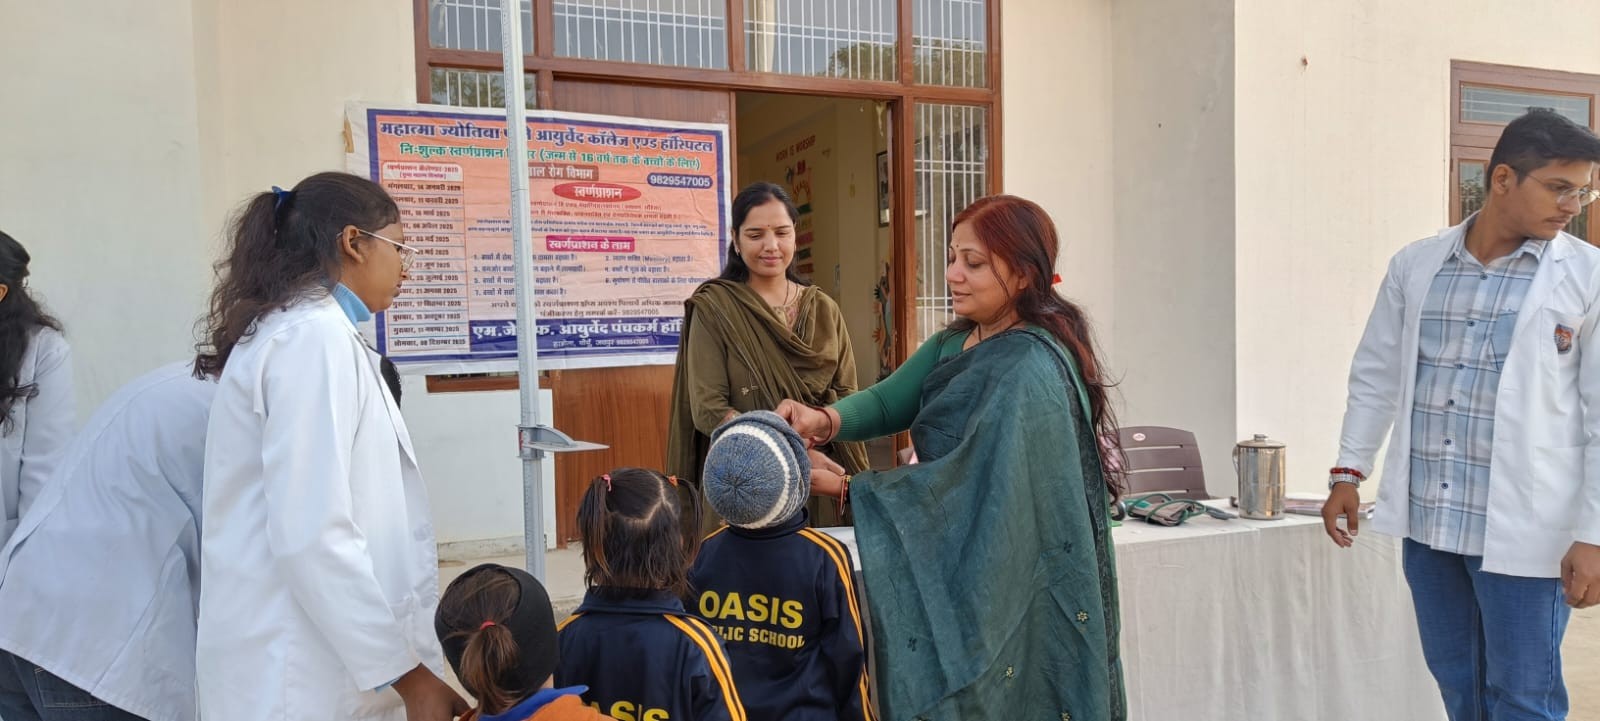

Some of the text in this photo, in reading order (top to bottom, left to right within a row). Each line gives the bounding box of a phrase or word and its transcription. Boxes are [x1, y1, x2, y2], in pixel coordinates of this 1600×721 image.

[380, 123, 435, 136] महात्मा
[440, 121, 500, 138] ज्योतिबा
[536, 127, 583, 147] आयुर्वेद
[588, 129, 629, 147] कॉलेज
[632, 137, 657, 150] एण्ड
[661, 135, 712, 151] हॉस्पिटल
[540, 148, 565, 161] (जन्म
[569, 150, 577, 160] से
[581, 152, 593, 162] 16
[597, 152, 610, 164] वर्ष
[613, 155, 628, 164] तक
[632, 153, 640, 165] के
[667, 155, 674, 166] के
[549, 165, 563, 179] रोग
[566, 167, 593, 179] विभाग
[574, 182, 622, 198] स्वर्णप्राशन
[651, 176, 710, 187] 9829547005
[600, 238, 609, 250] के
[612, 240, 630, 250] लाभ
[560, 320, 608, 338] आयुर्वेद
[612, 318, 657, 334] पंचकर्म
[699, 590, 803, 629] OASIS
[712, 625, 805, 649] LIC SCHOOL
